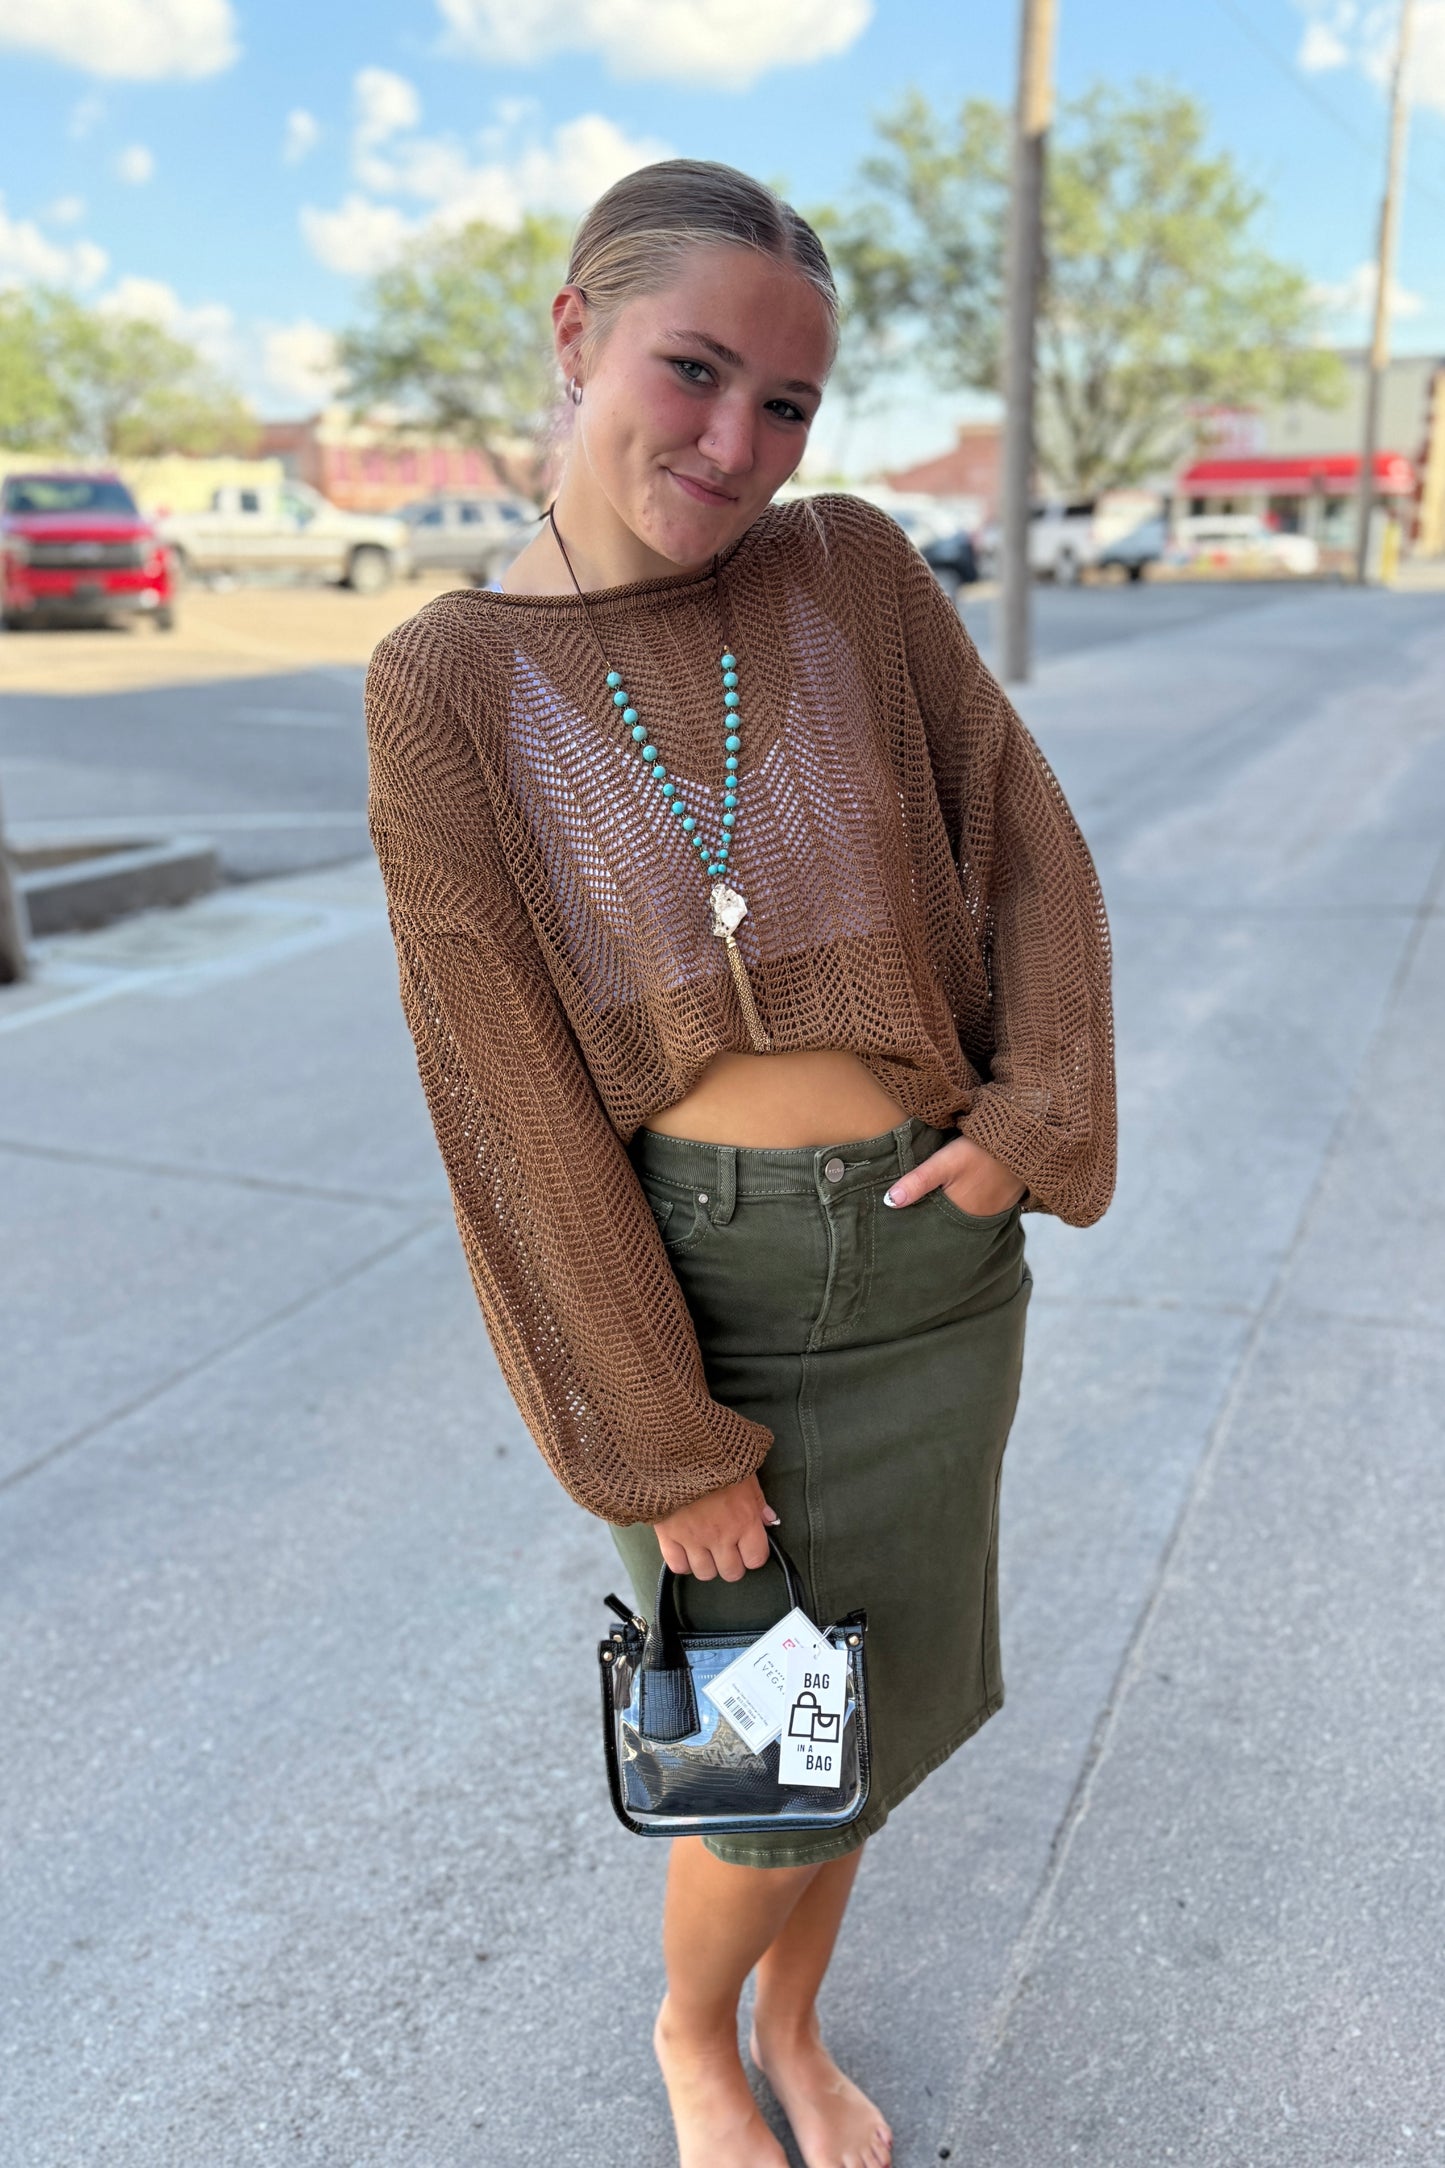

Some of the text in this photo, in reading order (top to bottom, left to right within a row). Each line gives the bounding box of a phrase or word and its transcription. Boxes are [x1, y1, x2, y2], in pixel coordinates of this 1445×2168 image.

[762, 1664, 785, 1695] VEGA
[804, 1672, 830, 1689] BAG
[797, 1744, 813, 1753] IN A
[806, 1754, 832, 1771] BAG
